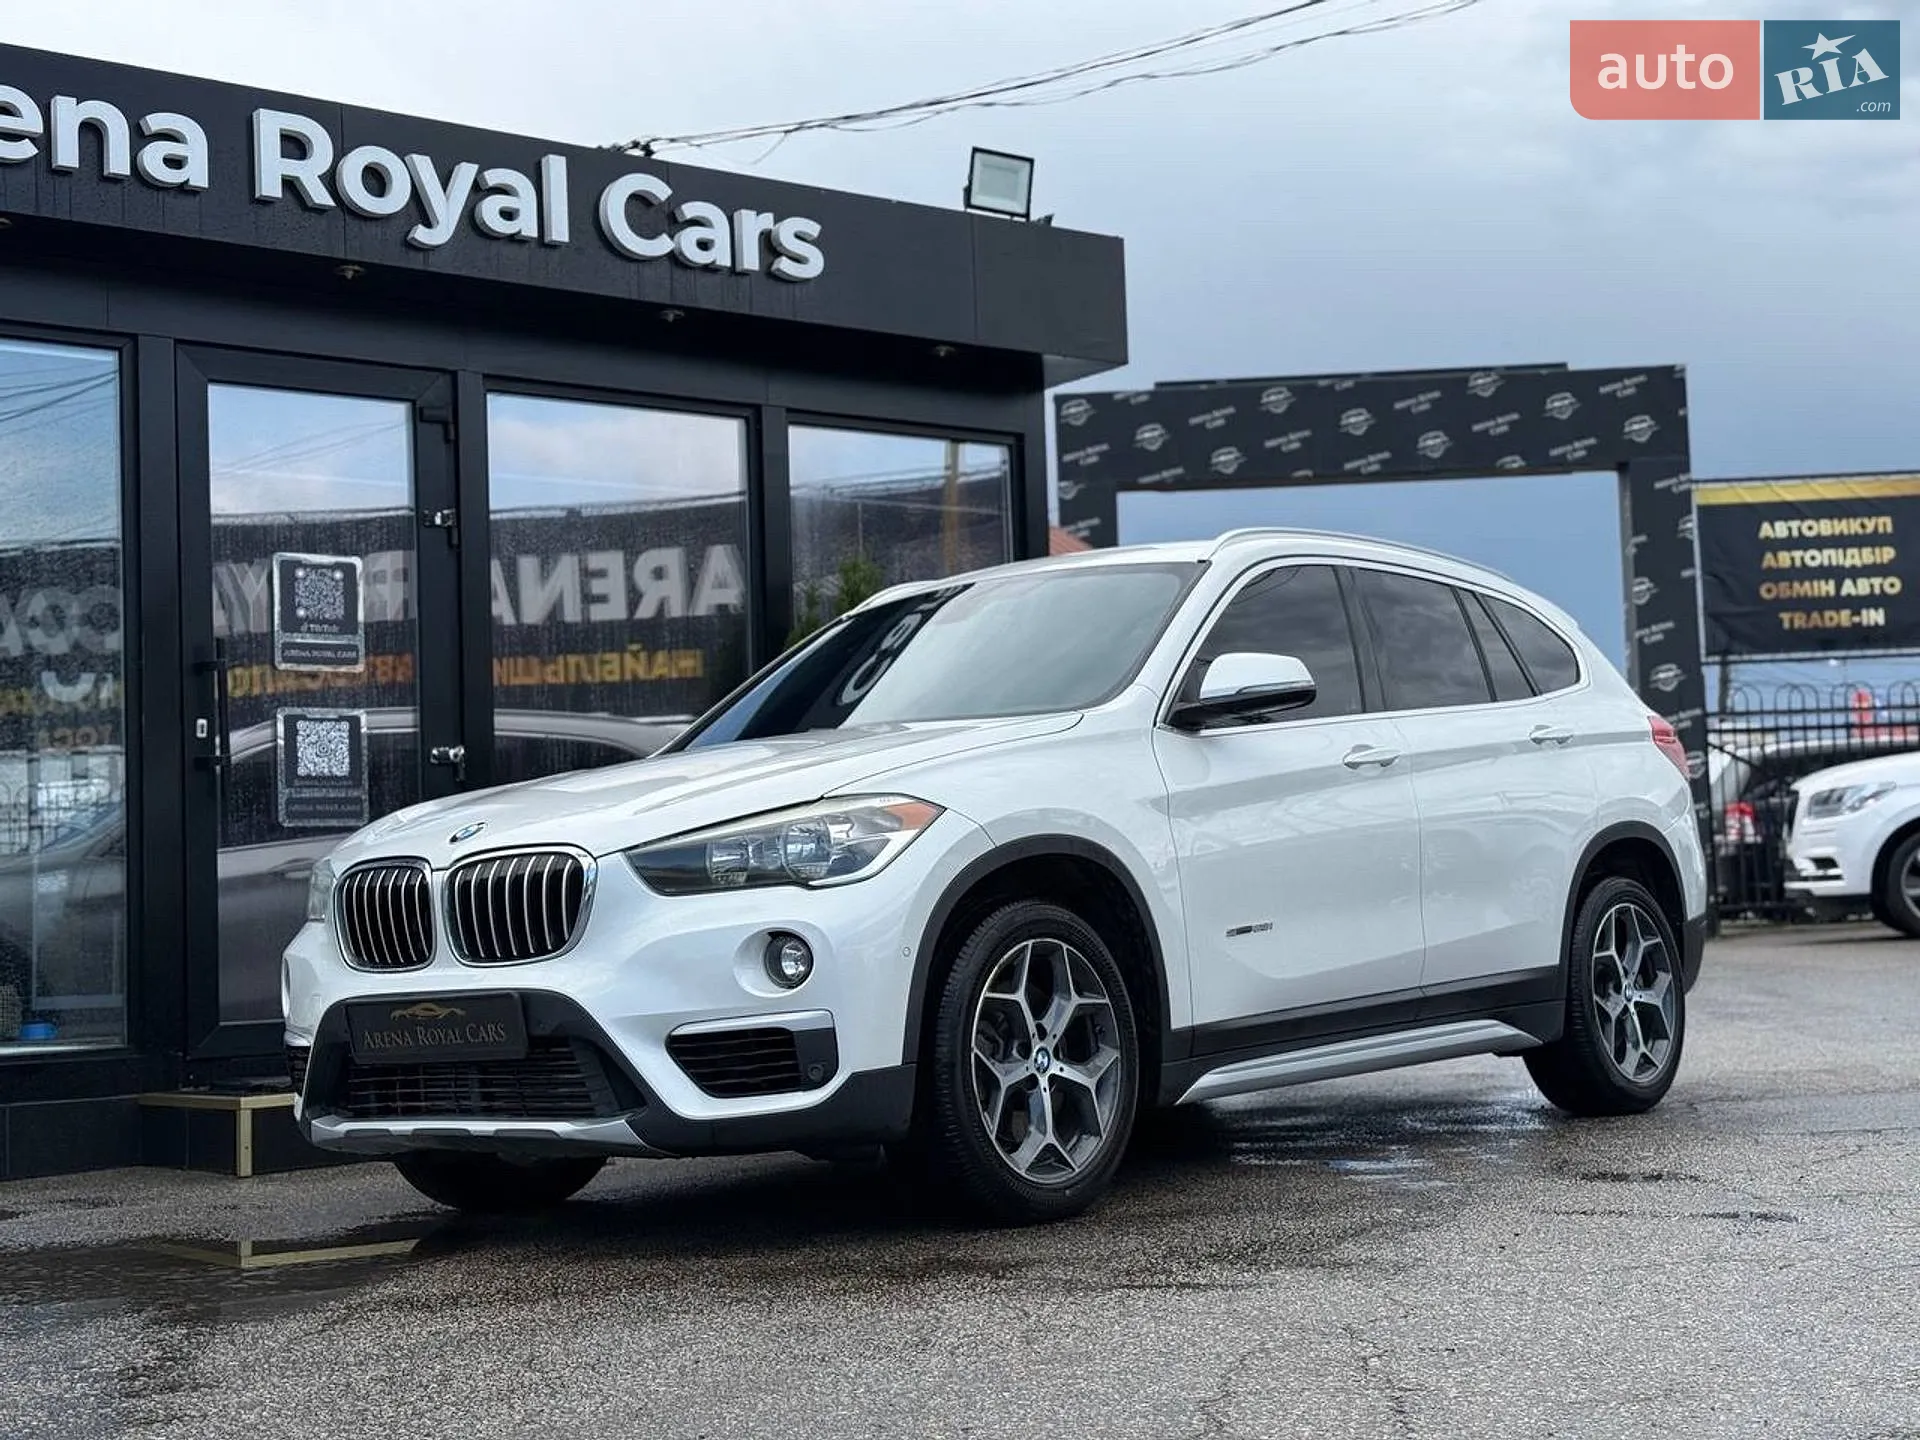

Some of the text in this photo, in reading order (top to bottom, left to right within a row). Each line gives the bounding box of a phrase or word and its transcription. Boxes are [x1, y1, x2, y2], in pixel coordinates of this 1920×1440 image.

[253, 108, 571, 250] Royal
[599, 171, 826, 282] Cars
[1758, 516, 1893, 539] АВТОВИКУП
[1761, 545, 1897, 569] АВТОПІДБІР
[1759, 576, 1902, 600] ОБМІН АВТО
[1779, 607, 1885, 629] TRADE-IN
